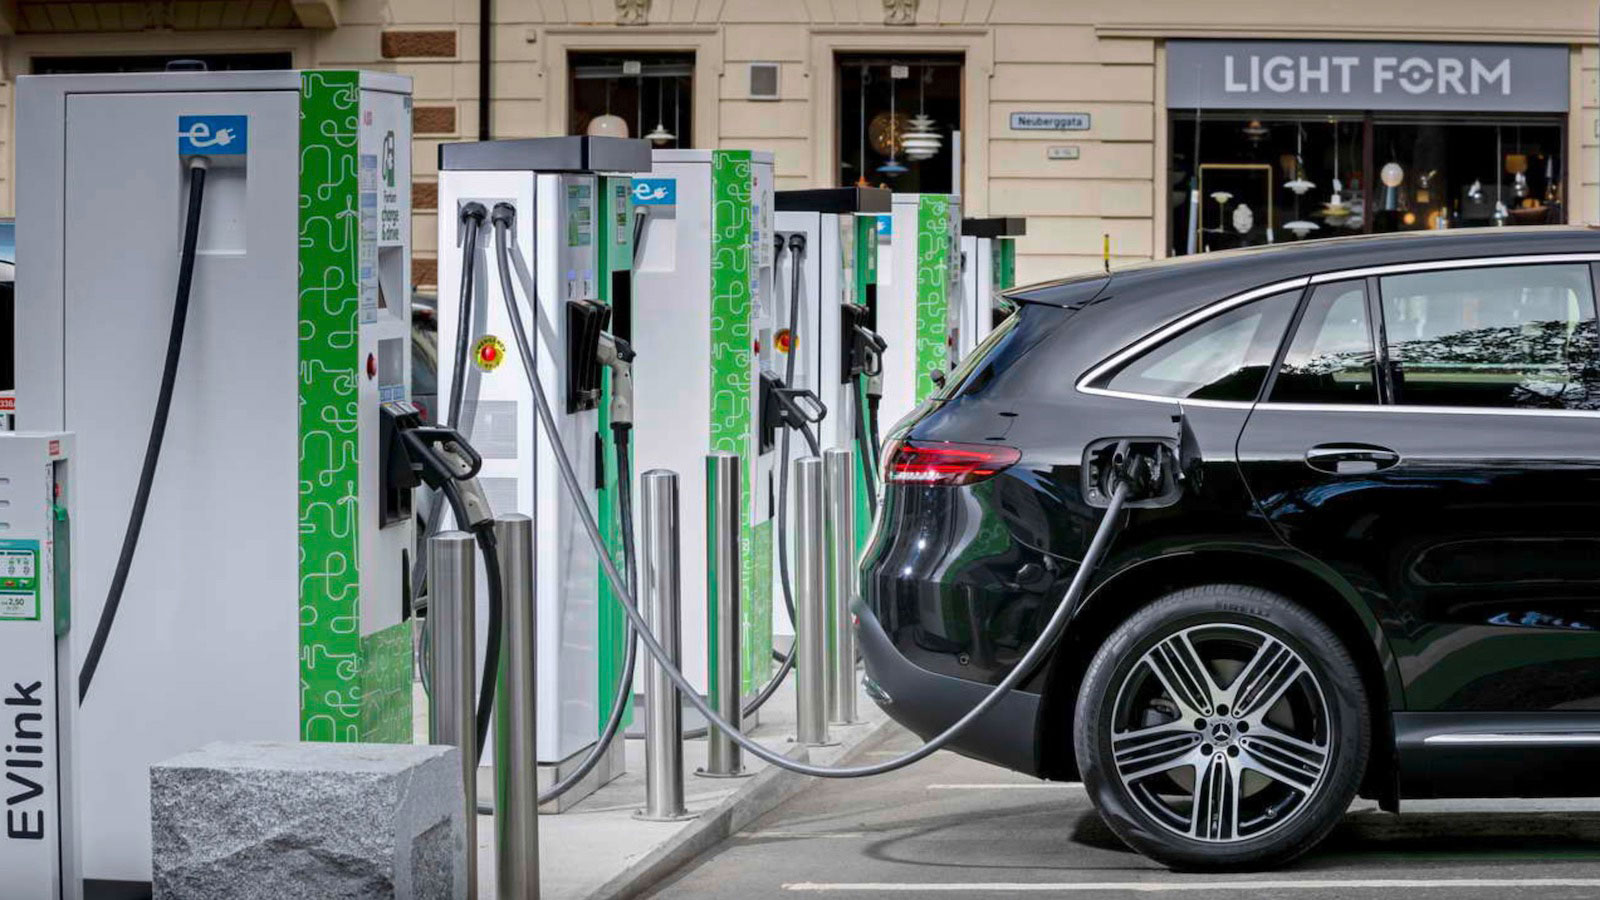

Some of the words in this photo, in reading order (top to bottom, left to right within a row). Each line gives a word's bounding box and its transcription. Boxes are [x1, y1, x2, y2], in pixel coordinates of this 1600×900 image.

[1225, 56, 1359, 93] LIGHT
[1373, 57, 1511, 95] FORM
[1018, 116, 1082, 129] Neuberggata
[381, 206, 400, 226] charge
[4, 681, 44, 840] EVlink
